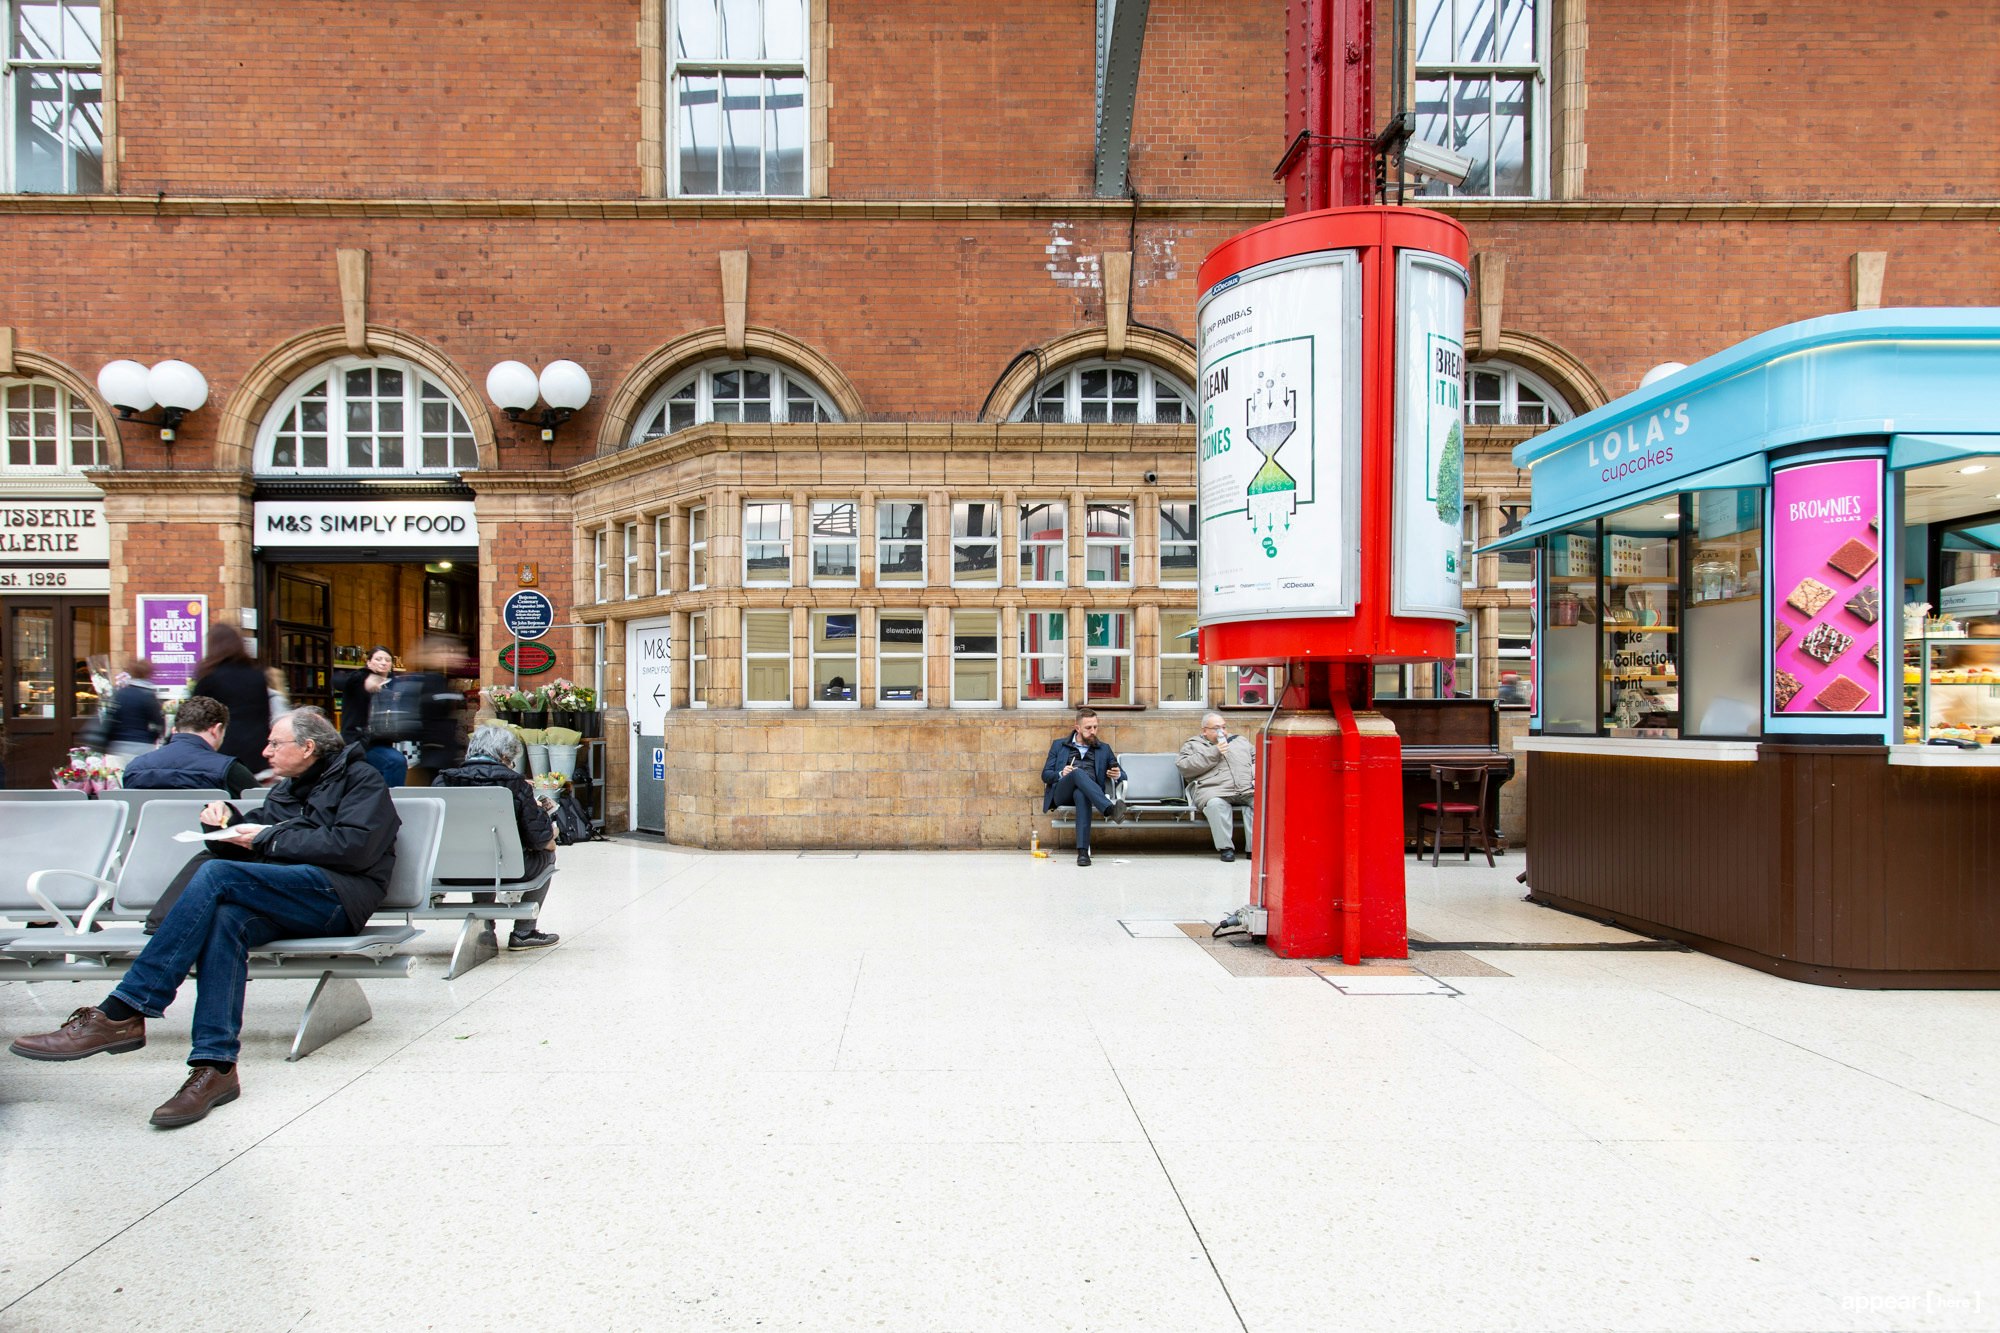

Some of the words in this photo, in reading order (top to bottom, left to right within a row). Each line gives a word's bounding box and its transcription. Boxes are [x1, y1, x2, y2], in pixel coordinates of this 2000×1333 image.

[1217, 306, 1253, 329] PARIBAS
[1216, 333, 1235, 346] changing
[1236, 326, 1253, 337] world
[1203, 366, 1229, 404] CLEAN
[1435, 379, 1447, 406] IT
[1449, 382, 1458, 411] IN
[1203, 404, 1214, 434] AIR
[1202, 426, 1231, 462] ZONES
[1588, 402, 1690, 468] LOLA'S
[1601, 447, 1674, 482] cupcakes
[1789, 495, 1861, 522] BROWNIES
[267, 515, 312, 533] M&S
[320, 515, 397, 533] SIMPLY
[404, 515, 466, 533] FOOD
[27, 572, 67, 586] 1926
[150, 618, 197, 631] CHEAPEST
[1613, 629, 1643, 644] Cake
[642, 666, 660, 675] SIMPLY
[1613, 676, 1643, 690] Point
